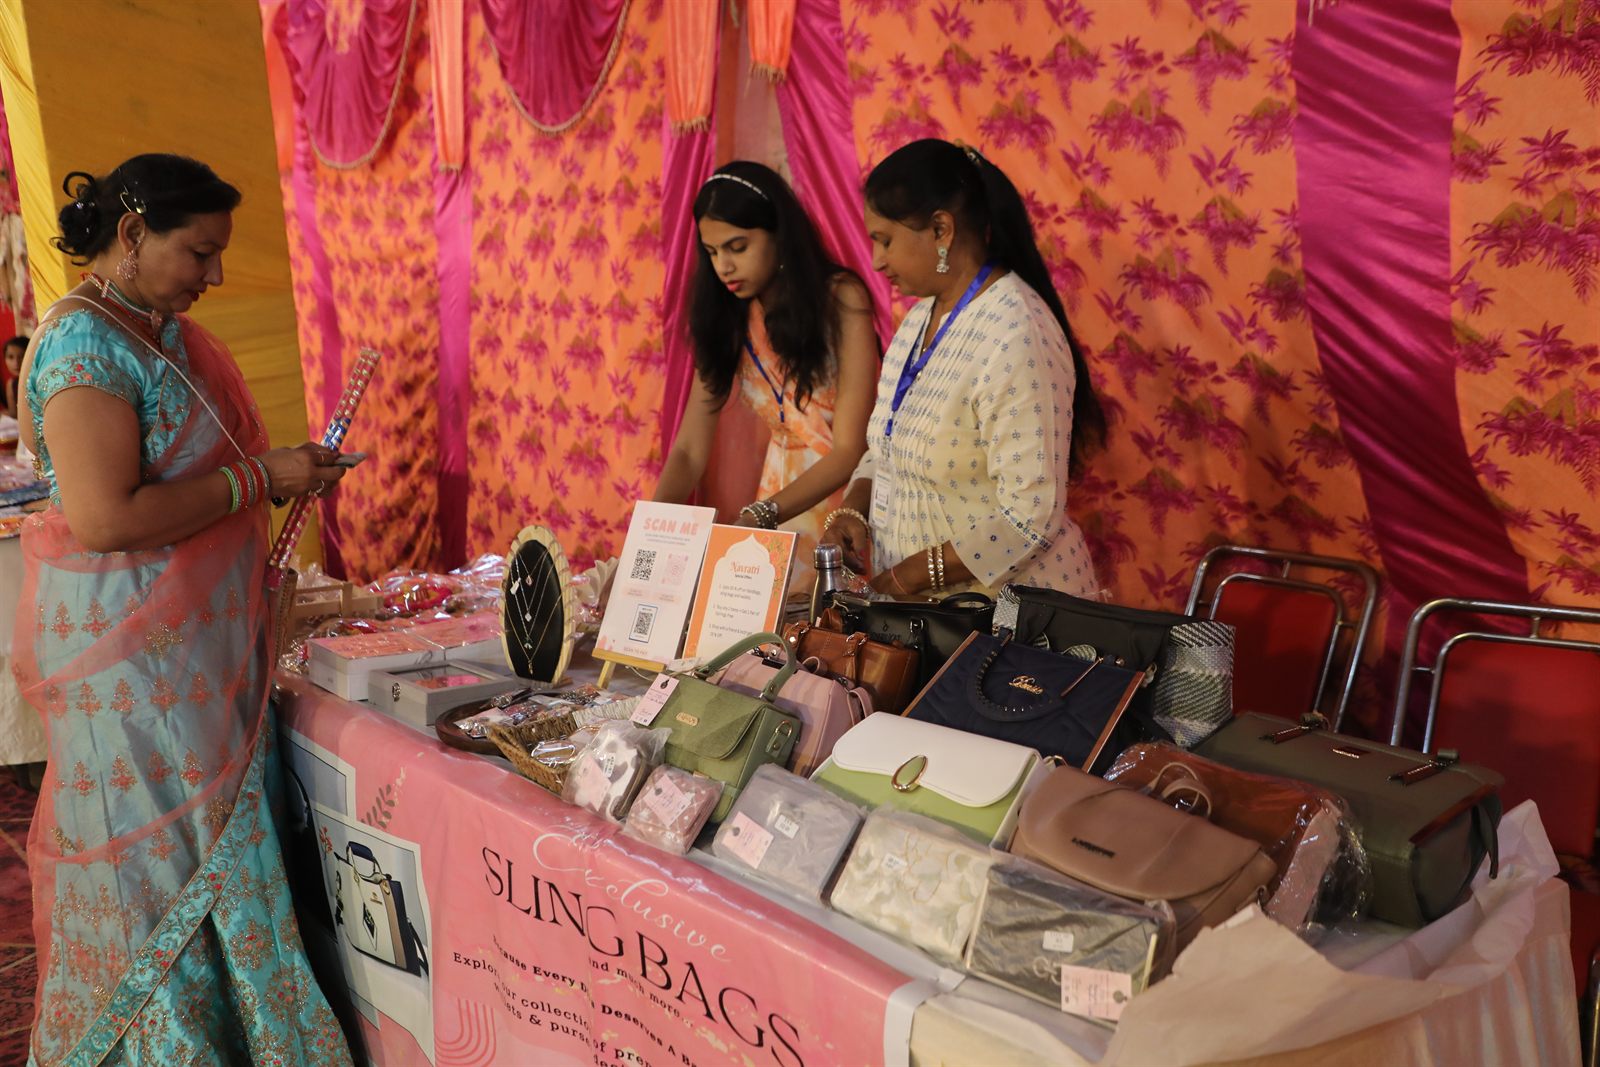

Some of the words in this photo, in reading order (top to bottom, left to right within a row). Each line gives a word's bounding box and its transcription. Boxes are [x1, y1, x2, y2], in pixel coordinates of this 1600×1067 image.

[643, 518, 677, 533] SCAN
[680, 521, 699, 536] ME
[529, 1014, 541, 1026] &
[533, 966, 576, 987] Every
[601, 1004, 663, 1046] Deserves
[668, 1045, 676, 1056] A
